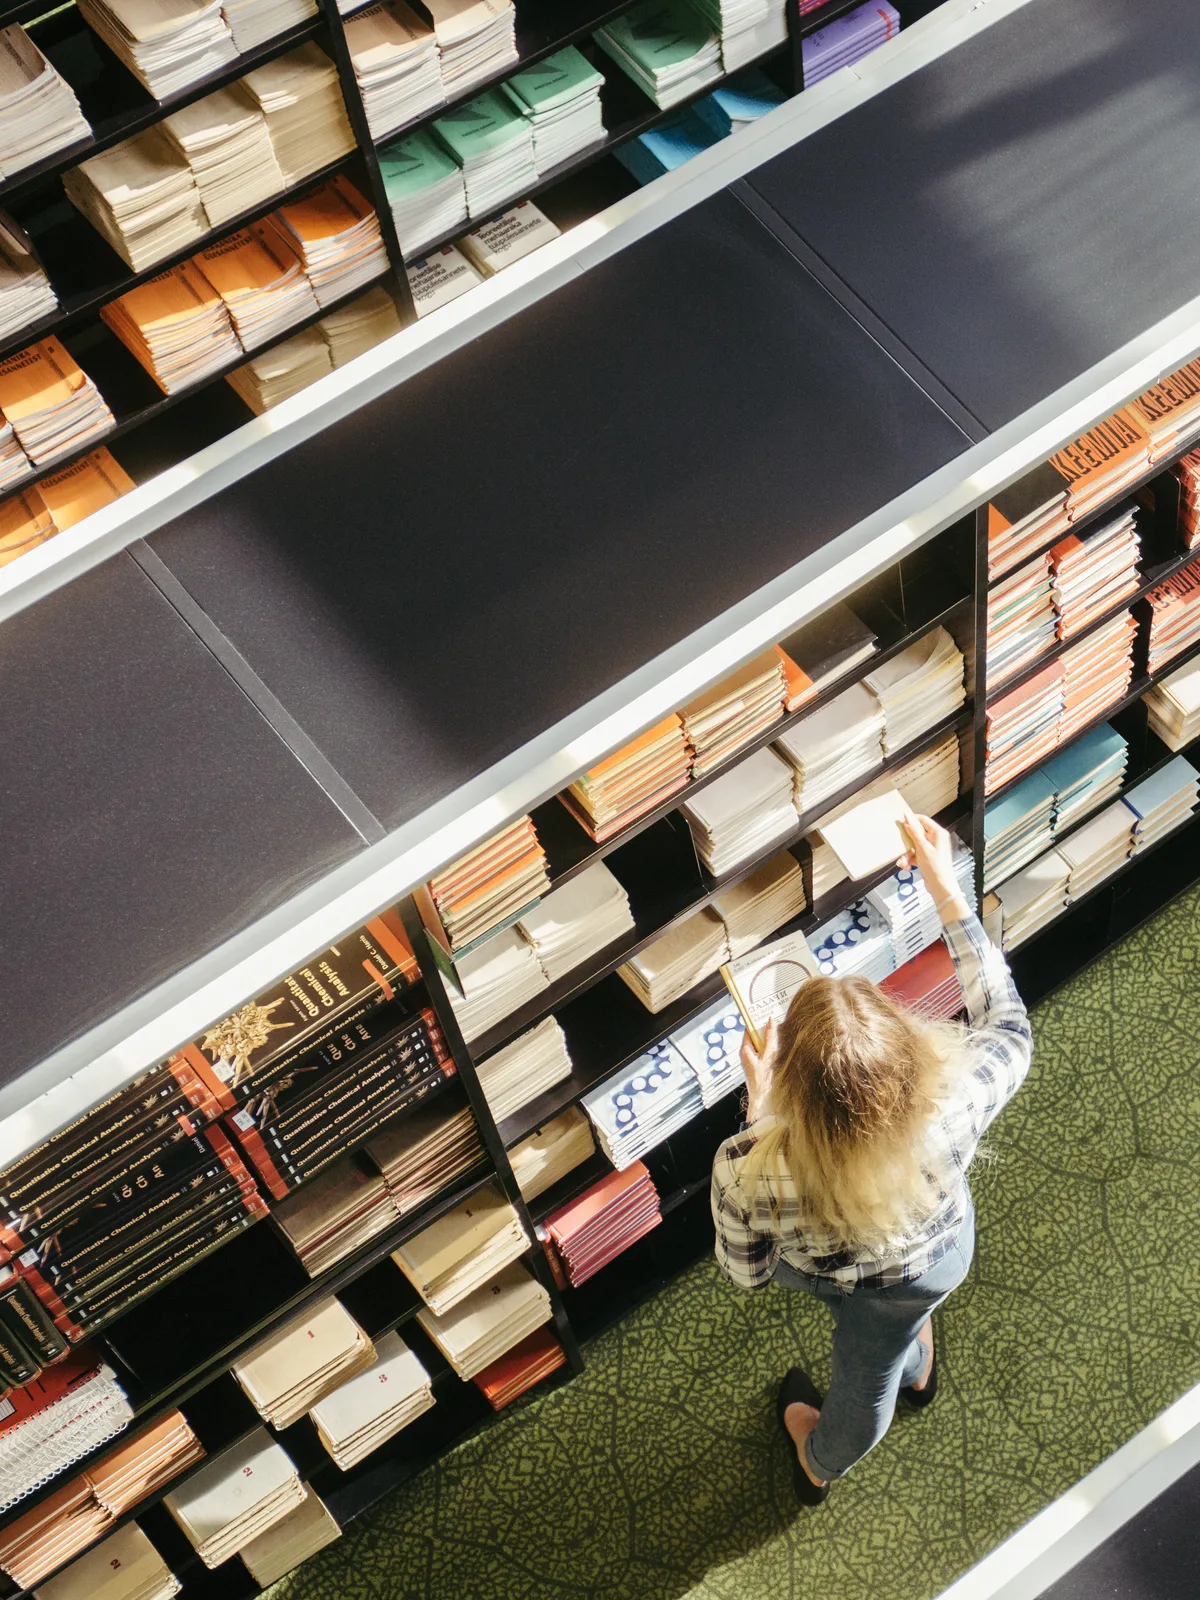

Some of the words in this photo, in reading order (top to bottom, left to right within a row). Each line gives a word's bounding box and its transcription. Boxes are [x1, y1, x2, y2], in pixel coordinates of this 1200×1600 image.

[409, 262, 442, 283] oreetilise
[1051, 413, 1142, 483] KEEMIA
[319, 961, 350, 997] Analysis
[358, 934, 371, 949] Harris
[375, 956, 389, 970] Daniel
[284, 975, 320, 1018] Quantitat
[299, 968, 334, 1007] Chemical
[251, 1054, 298, 1087] Quantitative
[299, 1030, 334, 1054] Chemical
[334, 1008, 366, 1031] Analysis
[278, 1096, 323, 1129] Quantitative
[323, 1073, 357, 1098] Chemical
[357, 1052, 387, 1075] Analysis
[283, 1109, 327, 1141] Quantitative
[328, 1086, 361, 1110] Chemical
[361, 1064, 391, 1087] Analysis
[290, 1124, 334, 1156] Quantitative
[334, 1101, 366, 1124] Chemical
[366, 1079, 396, 1101] Analysis
[296, 1135, 339, 1167] Quantitative
[340, 1112, 371, 1135] Chemical
[371, 1090, 400, 1112] Analysis
[0, 1141, 50, 1179] Quantitative
[50, 1117, 88, 1143] Chemical
[88, 1091, 122, 1117] Analysis
[9, 1162, 61, 1199] Quantitative
[61, 1136, 99, 1164] Chemical
[100, 1113, 134, 1139] Analysis
[19, 1177, 71, 1212] Quantitative
[71, 1153, 109, 1179] Chemical
[110, 1131, 145, 1155] Analysis
[303, 1146, 347, 1178] Quantitative
[347, 1124, 378, 1147] Chemical
[379, 1102, 408, 1124] Analysis
[40, 1194, 90, 1230] Quantitative
[91, 1168, 128, 1194] Chemical
[129, 1145, 162, 1171] Analysis
[60, 1233, 110, 1269] Quantitative
[110, 1210, 147, 1237] Chemical
[148, 1190, 181, 1215] Analysis
[75, 1250, 123, 1284] Quantitative
[124, 1228, 160, 1253] Chemical
[160, 1208, 193, 1230] Analysis
[88, 1280, 137, 1312] Quantitative
[137, 1257, 173, 1281] Chemical
[174, 1235, 206, 1258] Analysis
[242, 1466, 253, 1478] 2
[109, 1558, 122, 1570] 2
